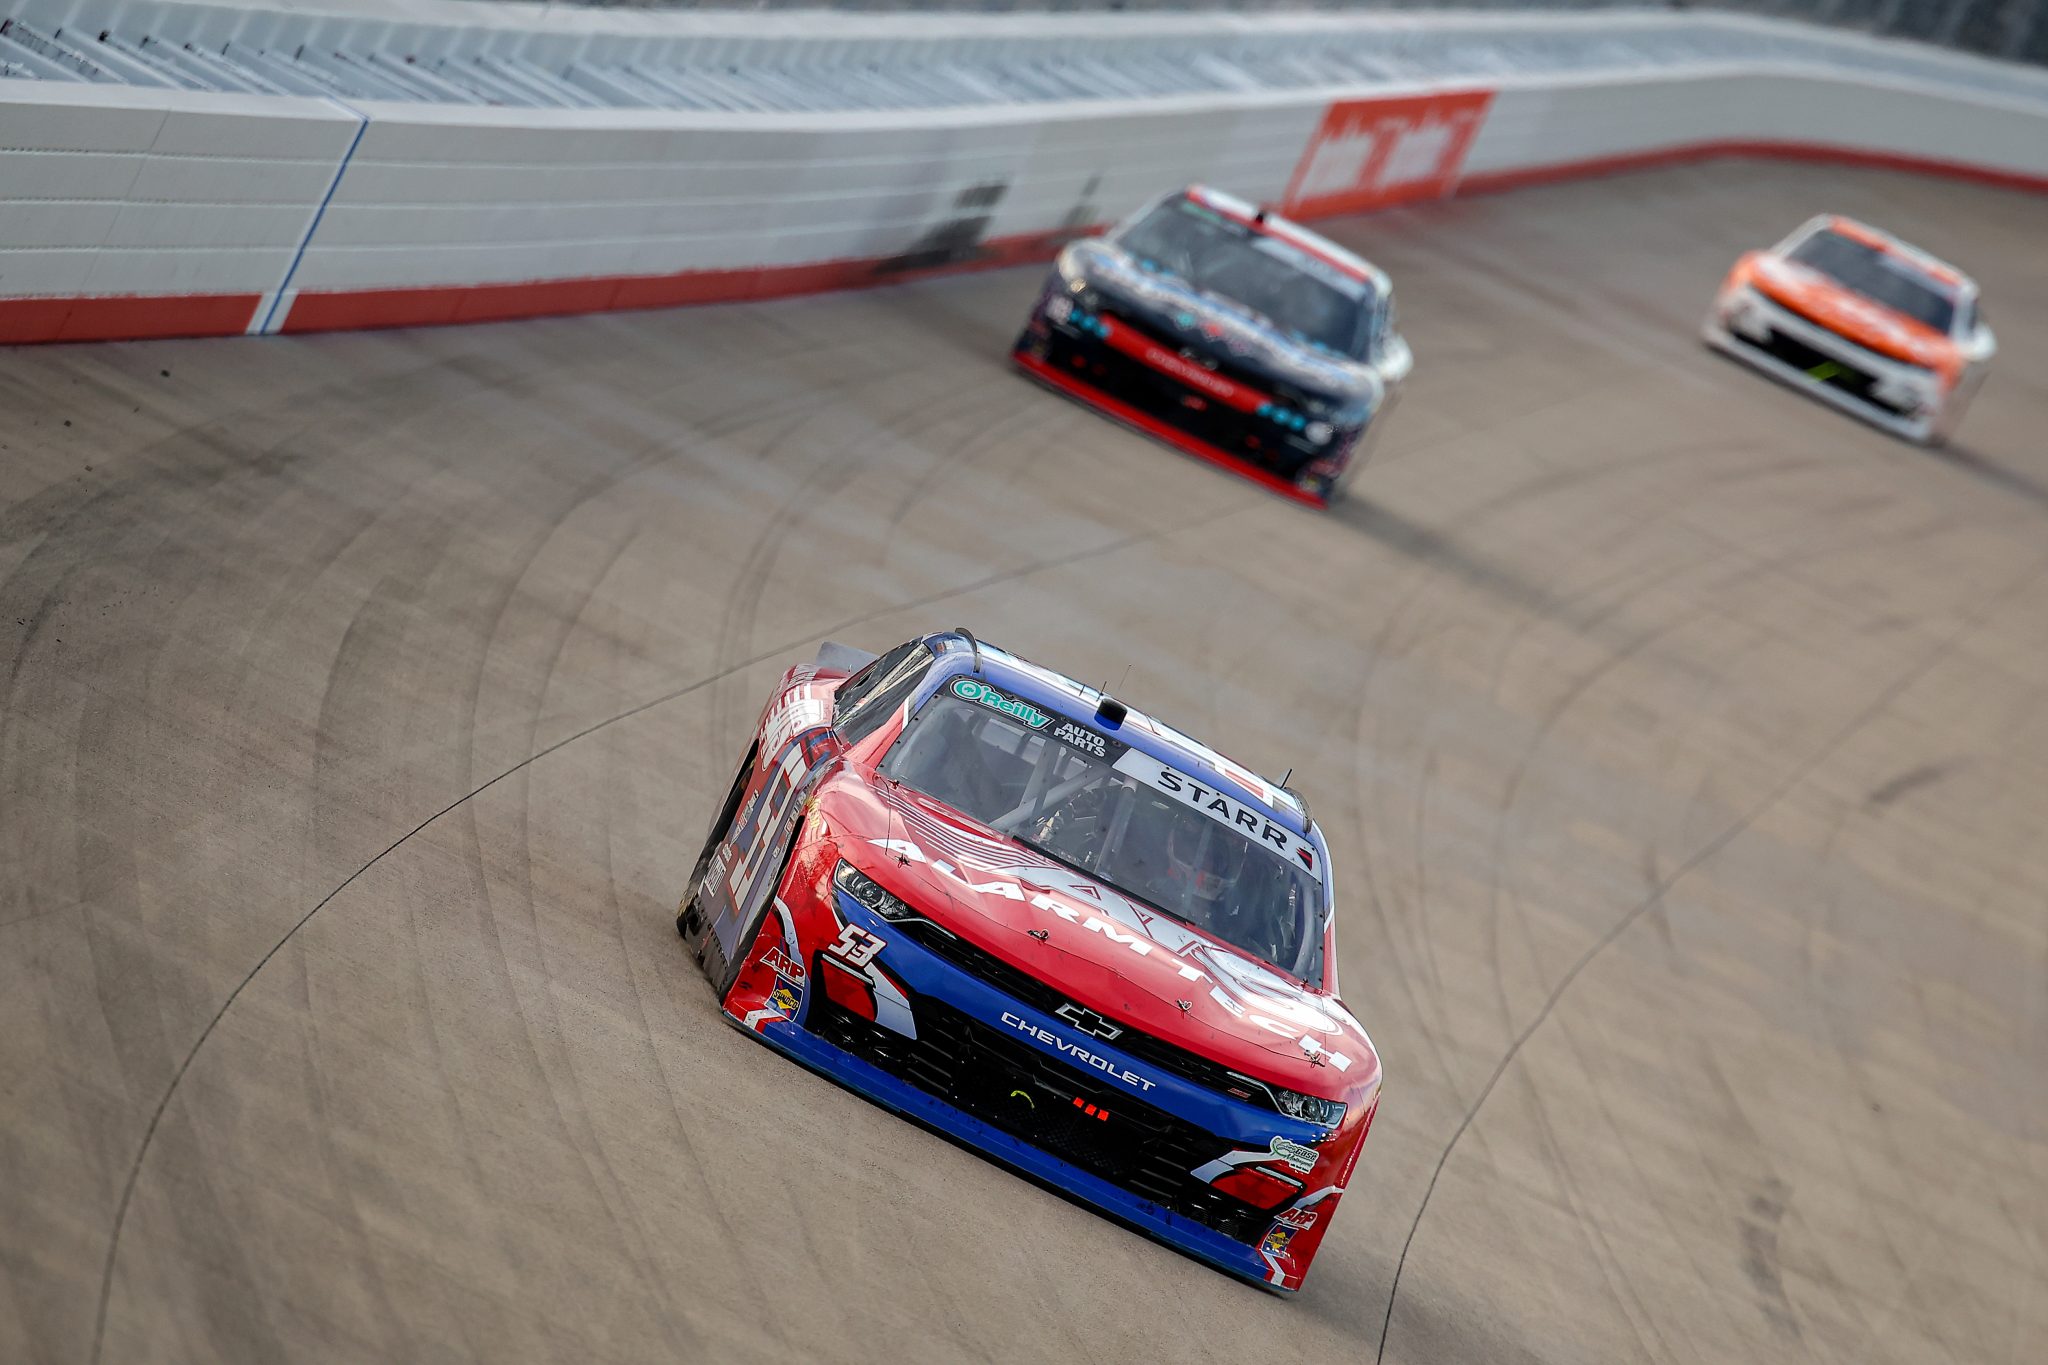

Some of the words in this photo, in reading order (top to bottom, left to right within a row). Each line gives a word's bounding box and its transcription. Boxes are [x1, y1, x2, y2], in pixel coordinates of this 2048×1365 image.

[952, 677, 1051, 729] O'Reilly
[1054, 727, 1106, 757] PARTS
[1062, 722, 1105, 747] AUTO
[1157, 770, 1288, 851] STARR
[827, 922, 887, 968] 53
[761, 947, 806, 986] ARP
[772, 989, 800, 1010] SUNOCO
[1000, 1011, 1156, 1091] CHEVROLET
